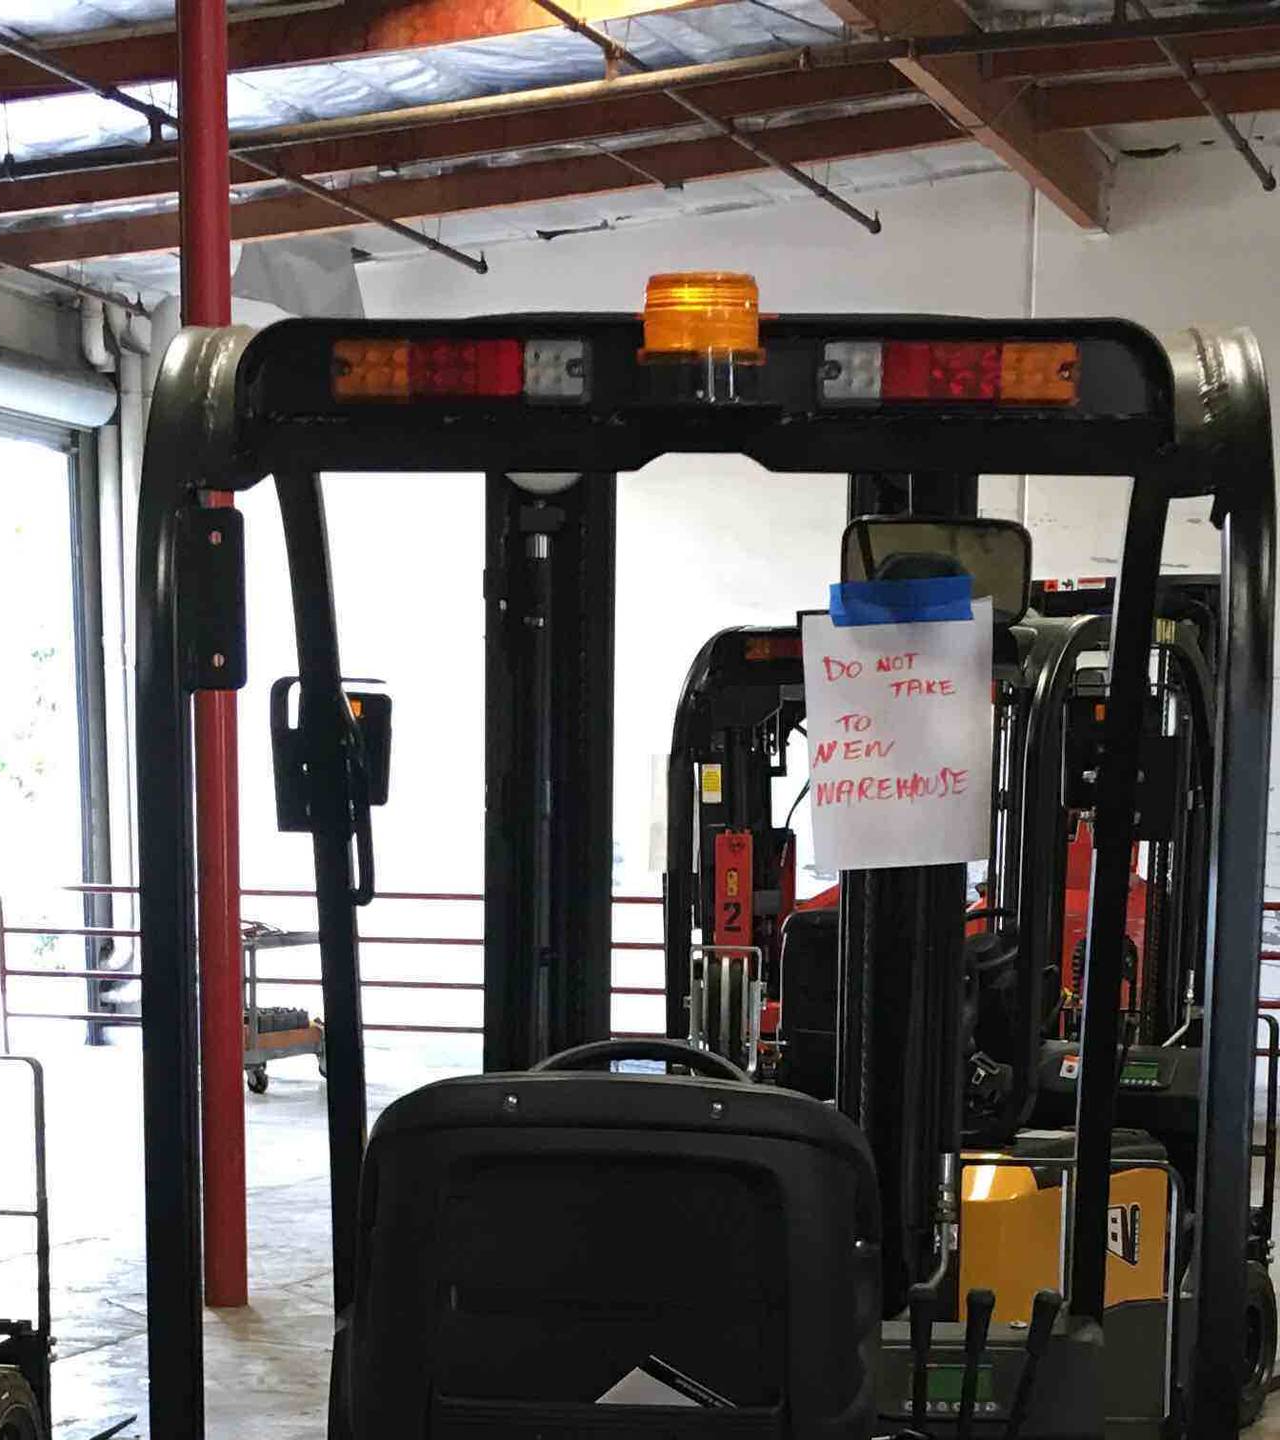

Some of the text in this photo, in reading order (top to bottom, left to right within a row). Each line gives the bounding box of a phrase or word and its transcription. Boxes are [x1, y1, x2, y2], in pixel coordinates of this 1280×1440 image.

[822, 653, 920, 681] DO NOT
[890, 678, 957, 698] TAKE
[835, 713, 871, 734] TO
[813, 739, 895, 768] NEW
[815, 767, 969, 807] WAREHOUSE
